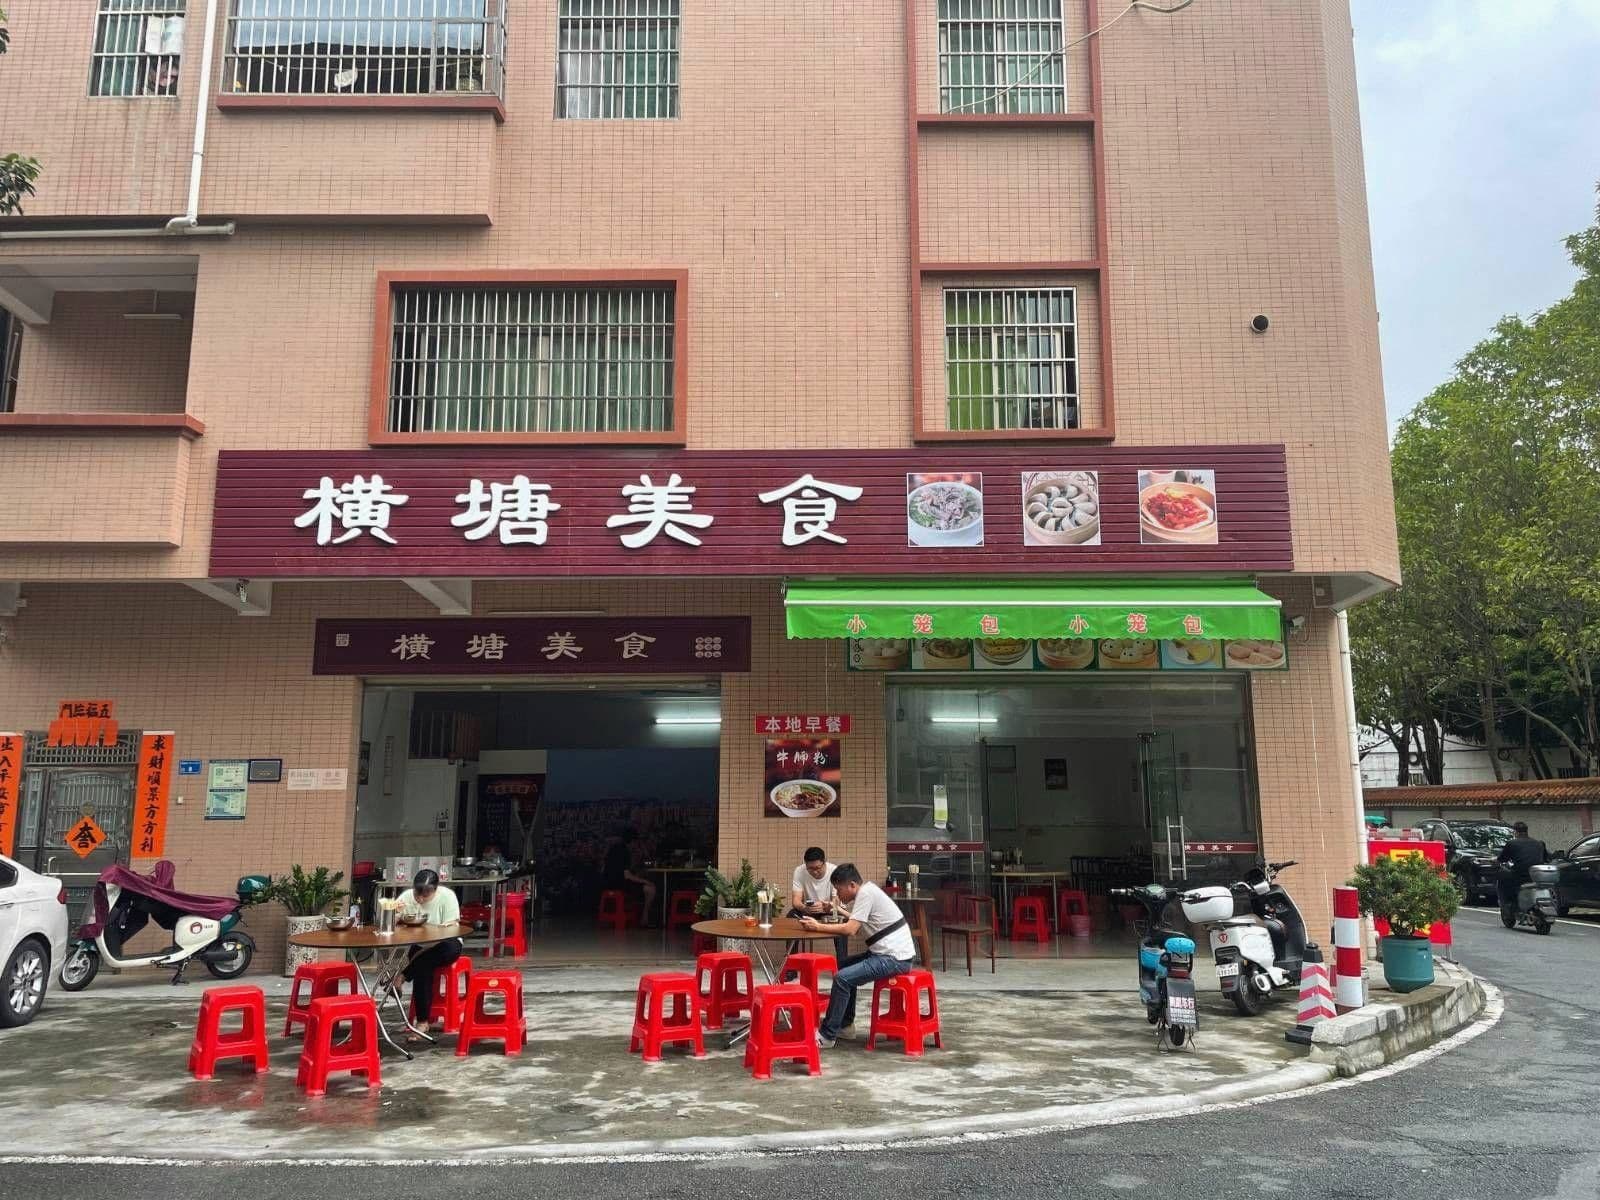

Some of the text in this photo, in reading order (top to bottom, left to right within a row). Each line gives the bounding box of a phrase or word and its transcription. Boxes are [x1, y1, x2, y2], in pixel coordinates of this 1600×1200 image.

[293, 473, 864, 548] 横塘美食
[847, 613, 1204, 635] 小笼包 小笼包
[391, 631, 657, 661] 横塘美食
[764, 715, 842, 734] 本地早餐
